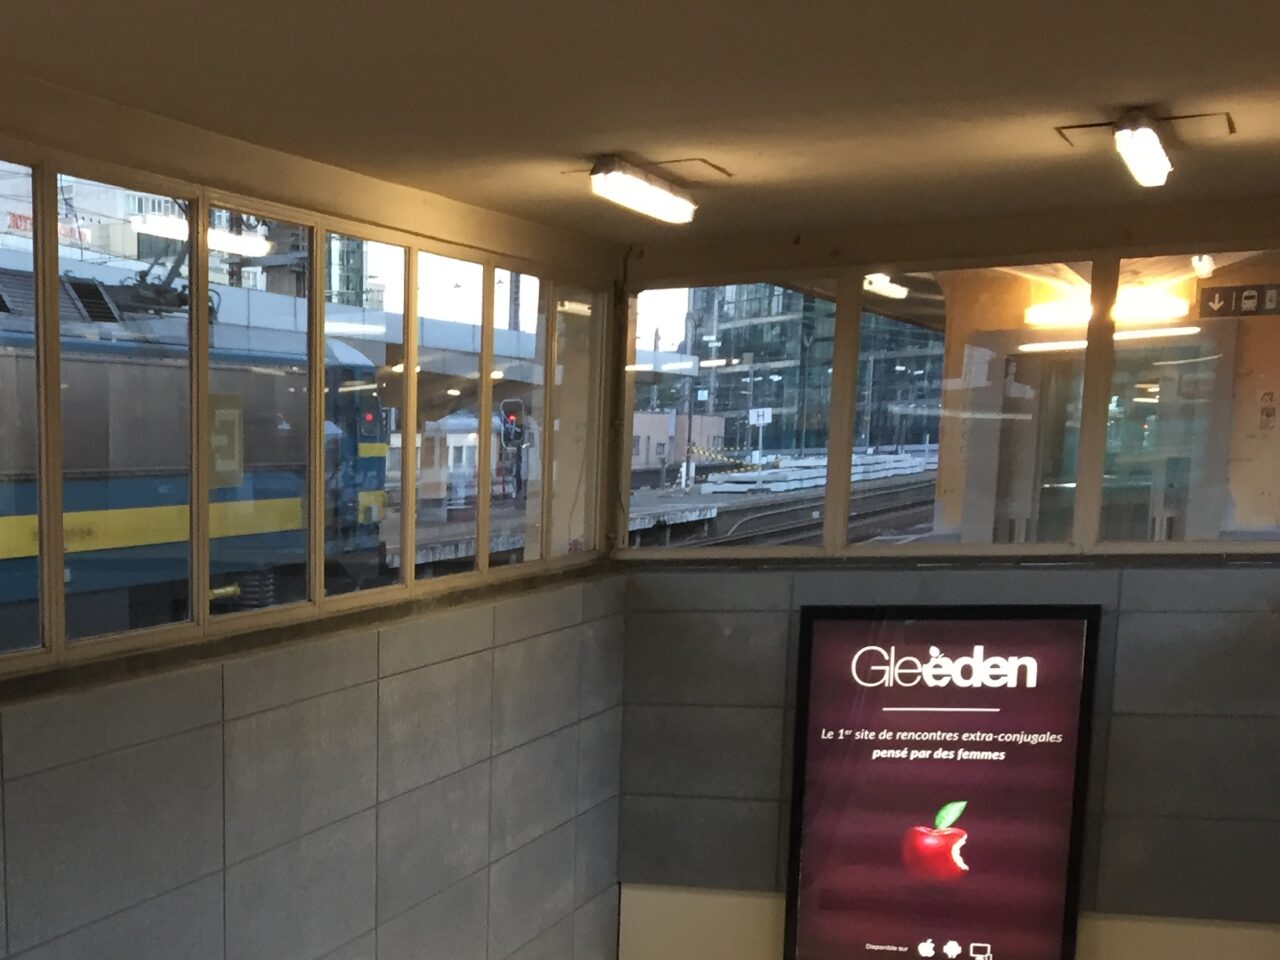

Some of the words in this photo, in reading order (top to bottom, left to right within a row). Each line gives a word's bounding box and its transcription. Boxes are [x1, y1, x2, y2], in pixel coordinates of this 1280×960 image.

[821, 728, 834, 740] Le
[854, 729, 877, 741] site
[878, 729, 894, 741] de
[896, 730, 959, 742] rencontres
[961, 731, 1064, 745] extra-conjugales
[872, 747, 909, 760] pensé
[910, 750, 932, 760] par
[933, 748, 955, 760] des
[957, 748, 1006, 761] femmes
[865, 943, 897, 951] Disponible
